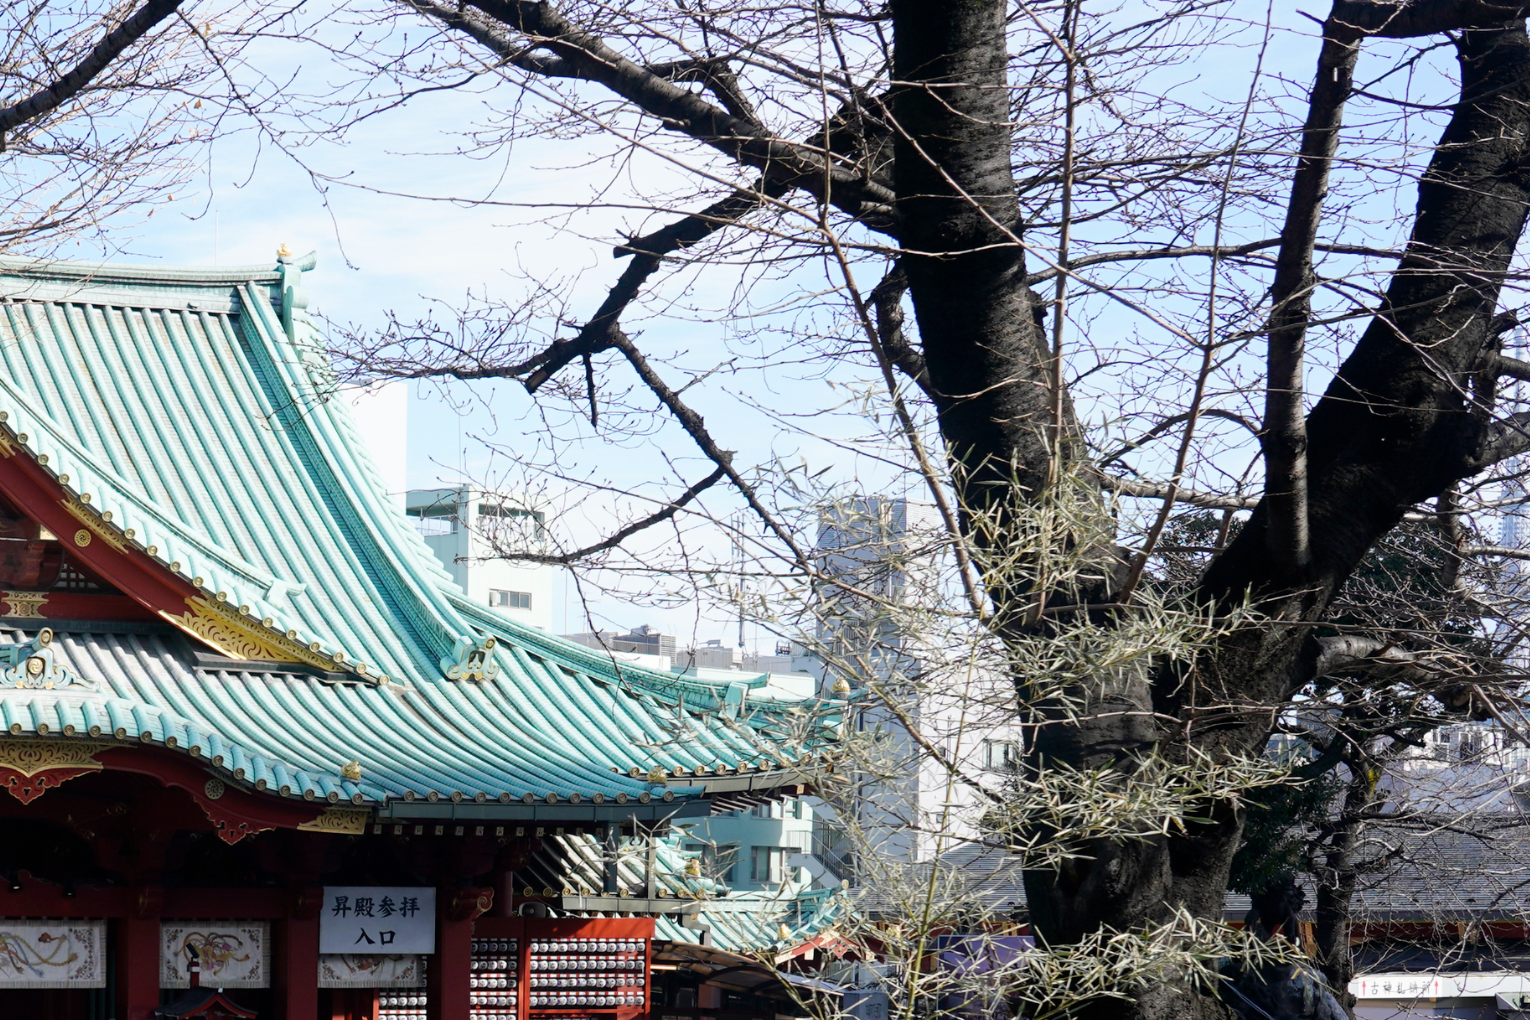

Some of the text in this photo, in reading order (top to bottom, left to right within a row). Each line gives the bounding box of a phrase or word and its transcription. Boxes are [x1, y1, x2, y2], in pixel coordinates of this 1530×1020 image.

[331, 895, 420, 918] 昇殿参拝
[354, 927, 396, 946] 入口
